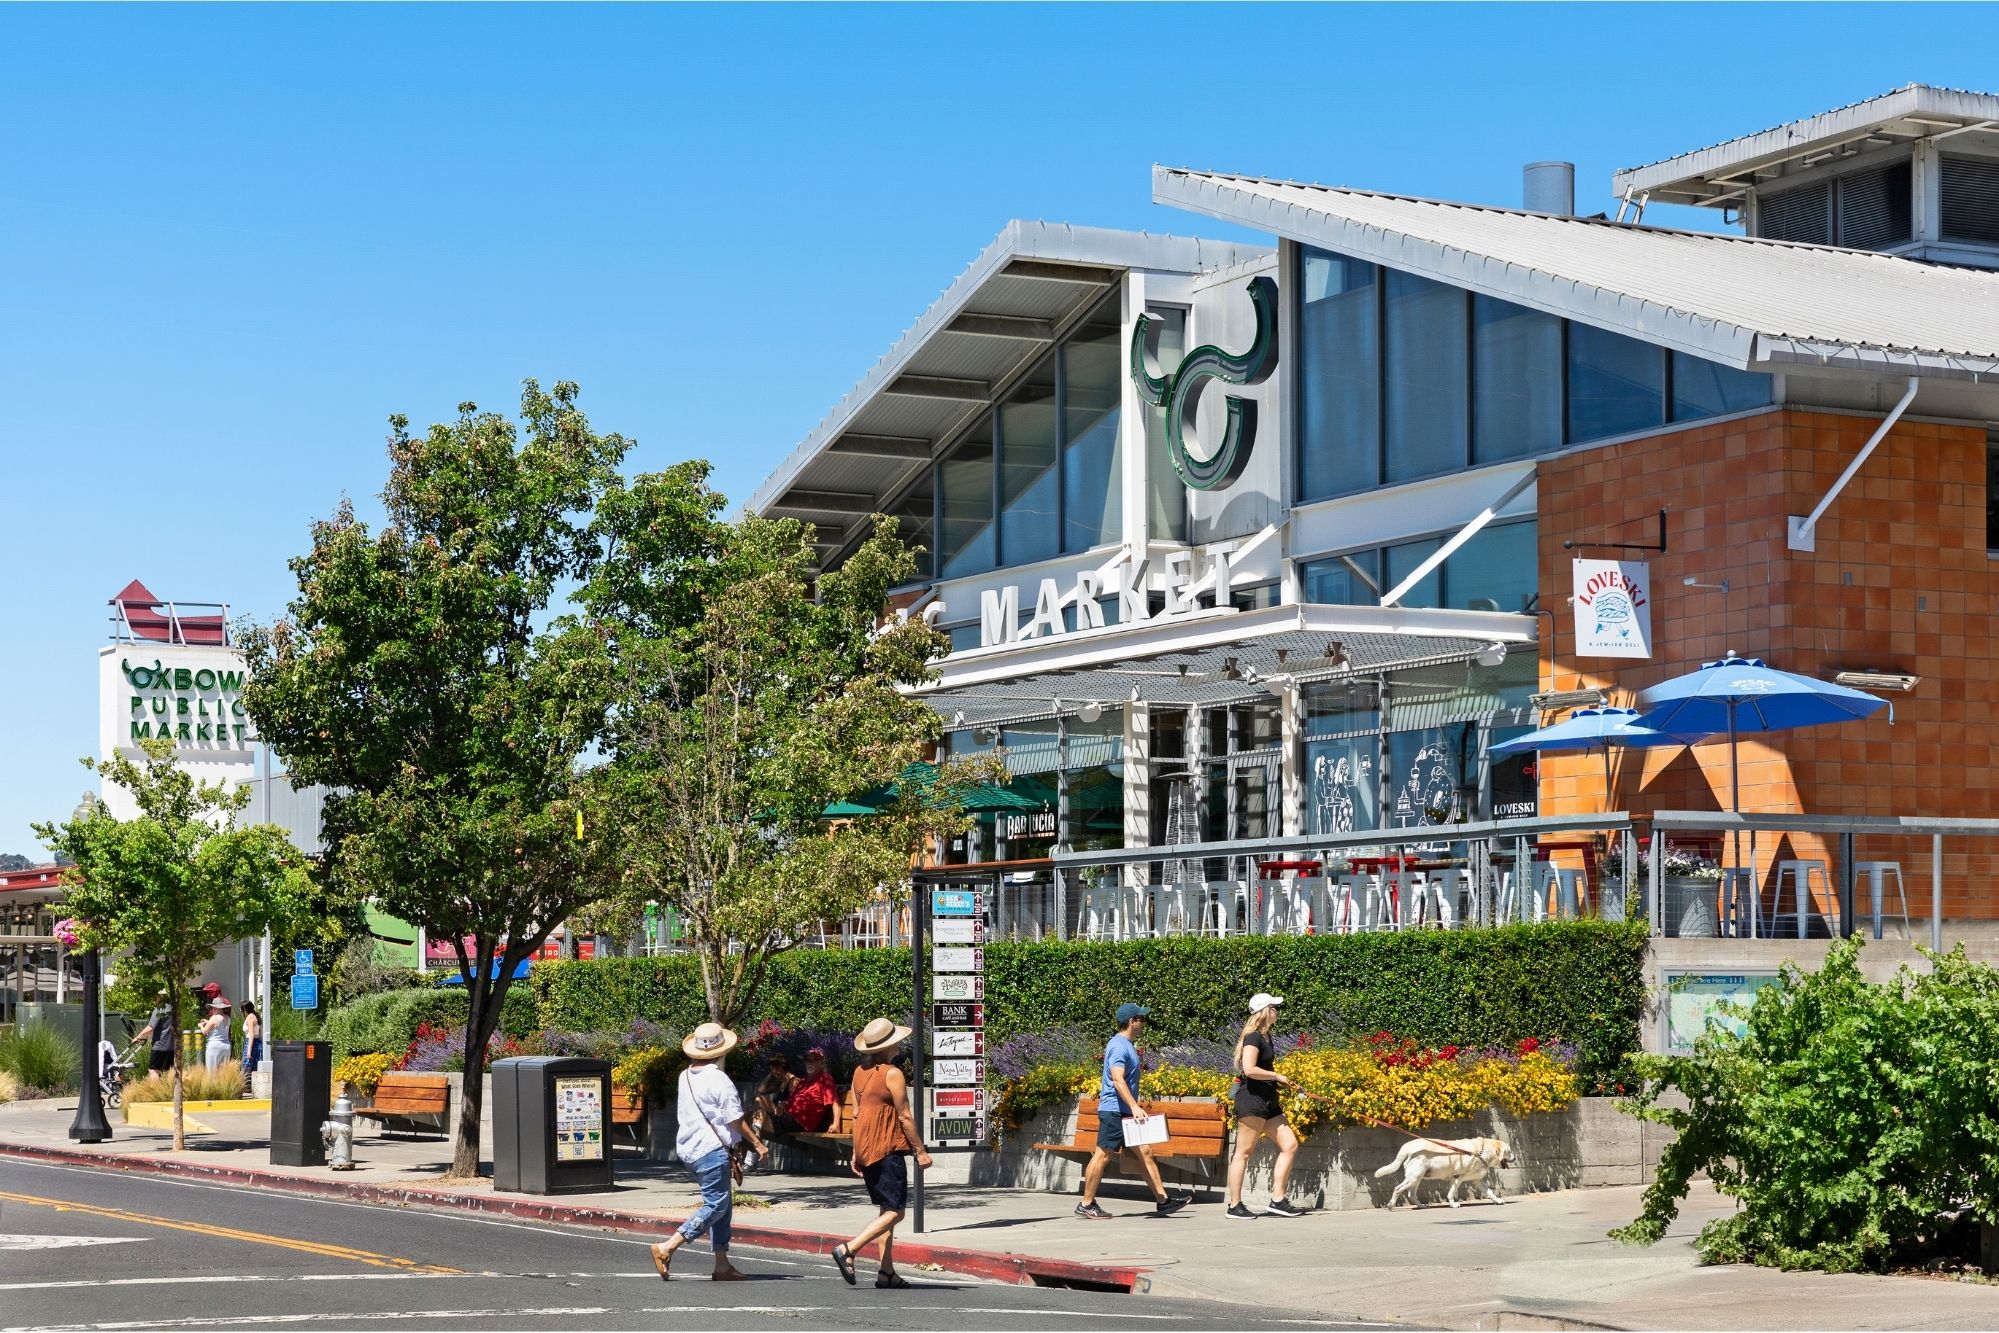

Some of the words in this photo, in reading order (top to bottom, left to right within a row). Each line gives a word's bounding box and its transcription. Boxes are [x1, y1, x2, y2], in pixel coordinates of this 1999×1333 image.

[981, 541, 1240, 647] MARKET
[1579, 571, 1647, 608] LOVESKI
[121, 658, 244, 692] OXBOW
[131, 696, 245, 716] PUBLIC
[130, 721, 245, 741] MARKET
[1494, 802, 1534, 815] LOVESKI
[1008, 815, 1027, 840] BAR
[942, 1006, 966, 1014] BANK
[938, 1120, 972, 1134] AVOW
